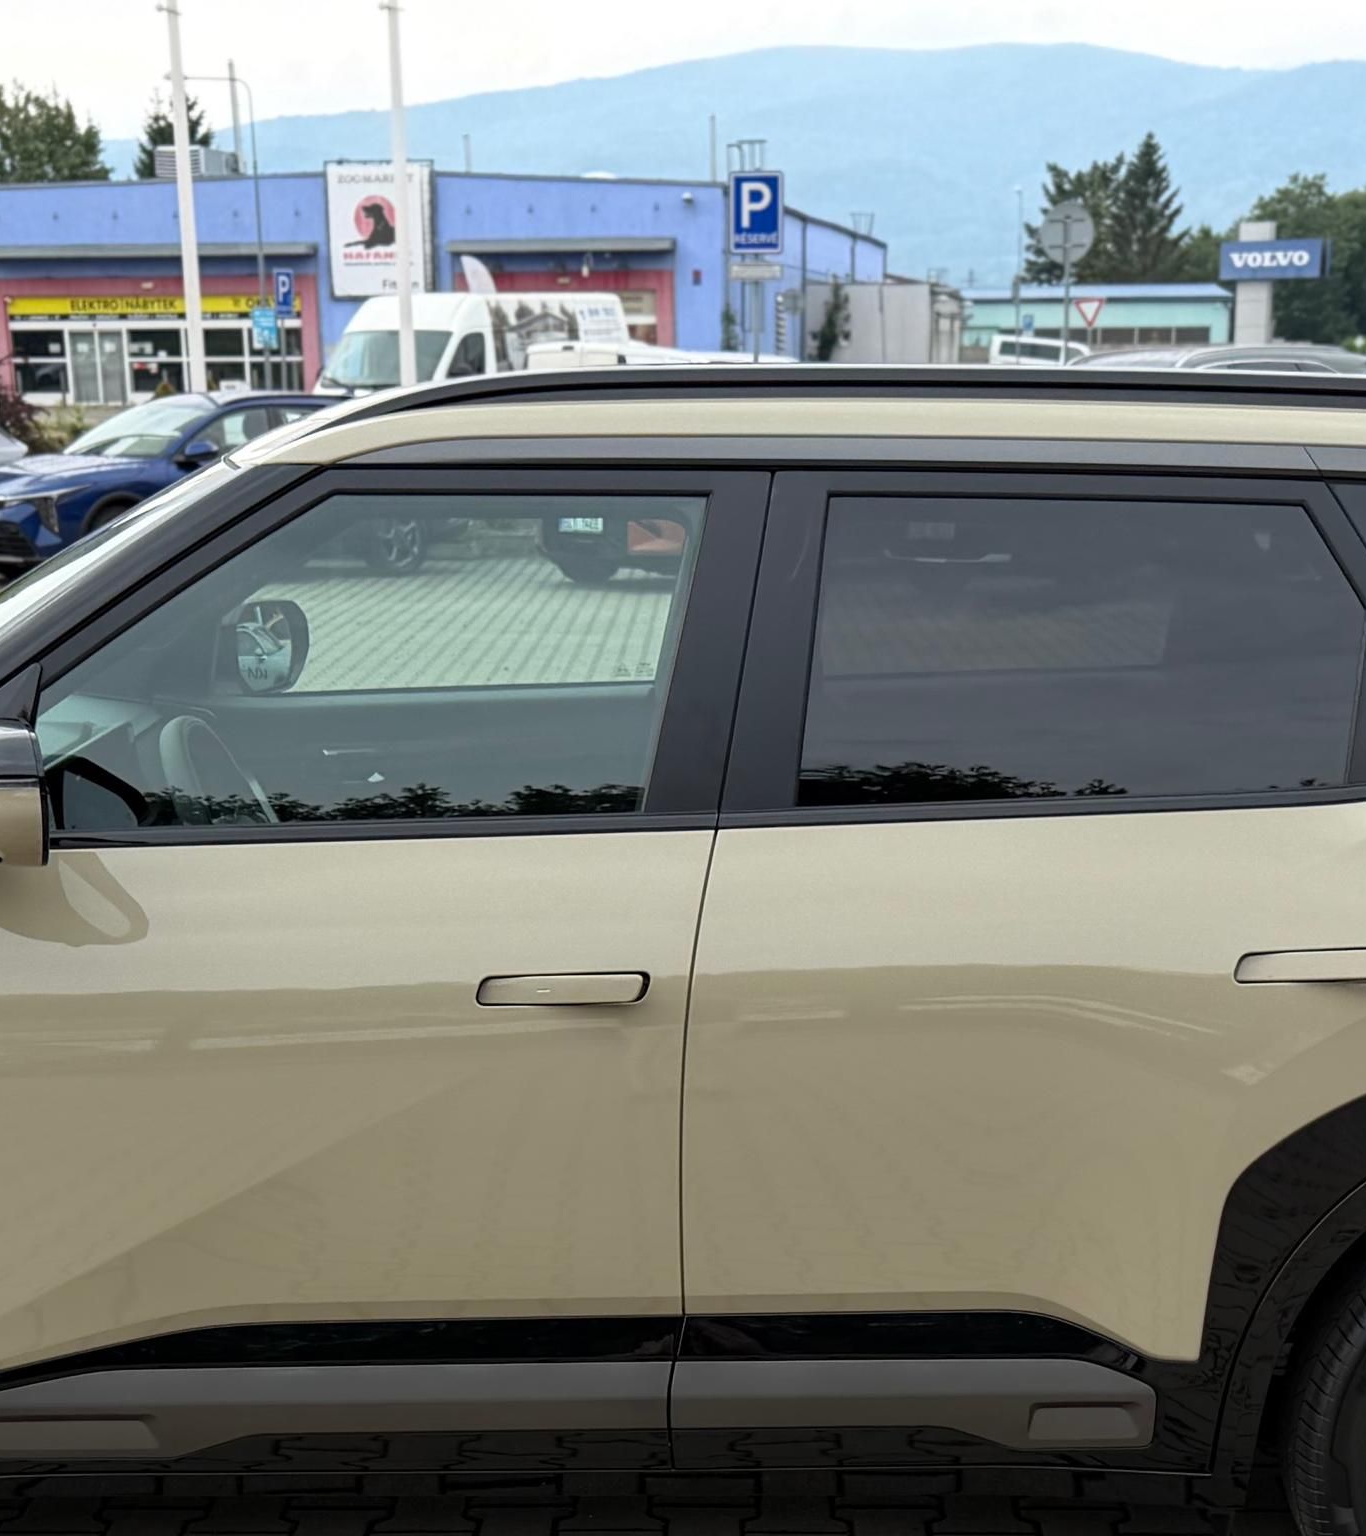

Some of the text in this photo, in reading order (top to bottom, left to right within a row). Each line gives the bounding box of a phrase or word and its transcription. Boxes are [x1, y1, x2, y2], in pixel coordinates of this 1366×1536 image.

[741, 182, 772, 229] P
[1229, 250, 1310, 268] VOLVO
[278, 275, 290, 303] P
[70, 299, 119, 311] ELEKTRO
